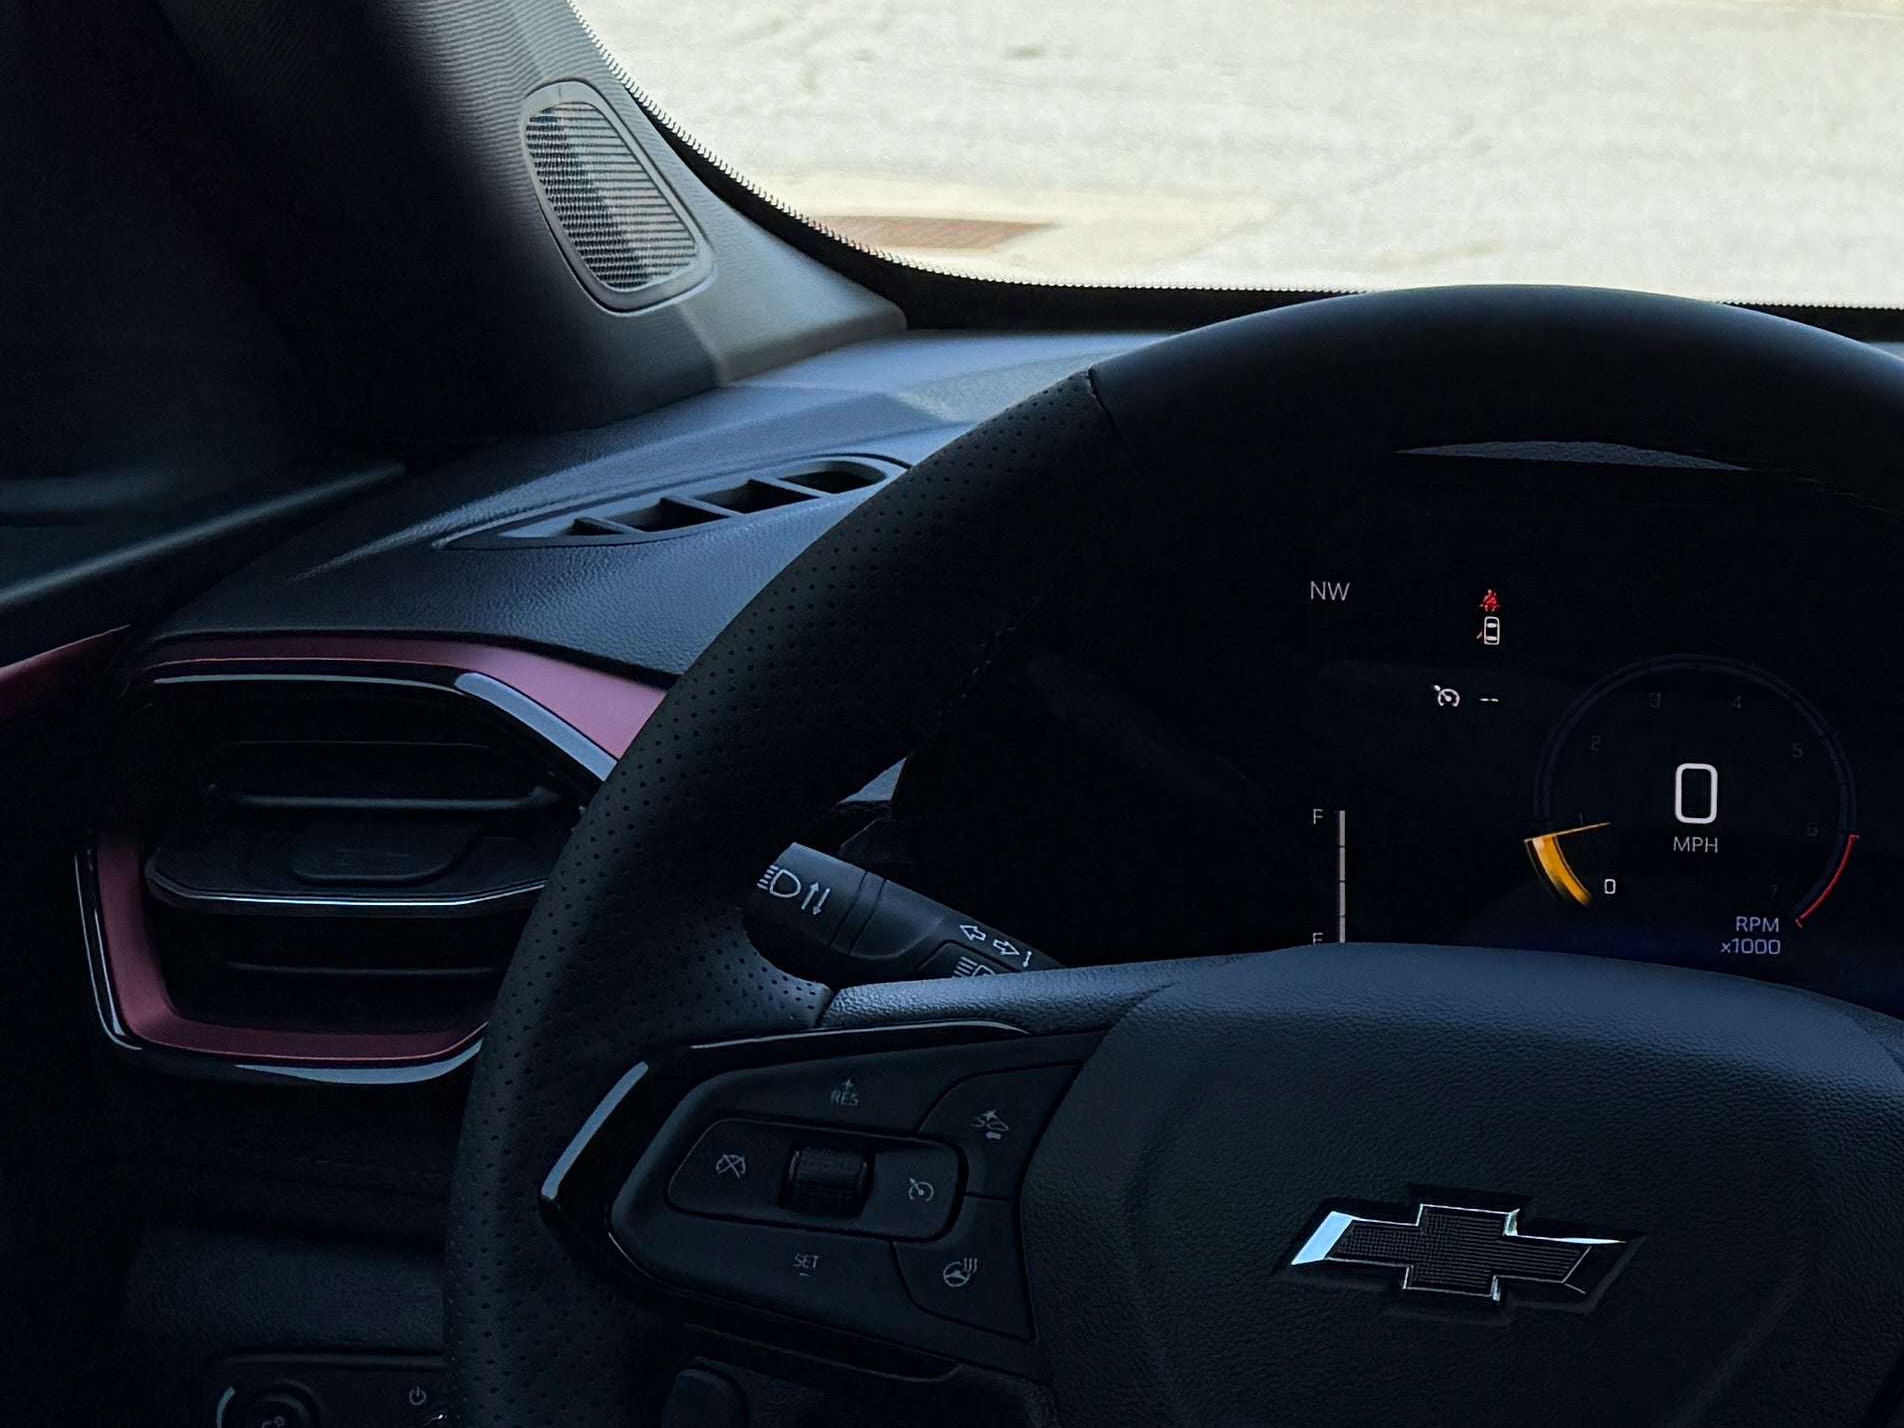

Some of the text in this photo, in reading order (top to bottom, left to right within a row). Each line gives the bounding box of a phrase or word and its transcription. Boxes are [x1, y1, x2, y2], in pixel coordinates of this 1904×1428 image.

[1310, 580, 1351, 602] NW
[1674, 762, 1718, 824] 0
[1312, 808, 1324, 825] F
[1673, 836, 1719, 854] MPH
[1736, 916, 1780, 933] RPM
[1720, 938, 1782, 955] x1000
[830, 1089, 859, 1106] RES
[793, 1252, 820, 1269] SET
